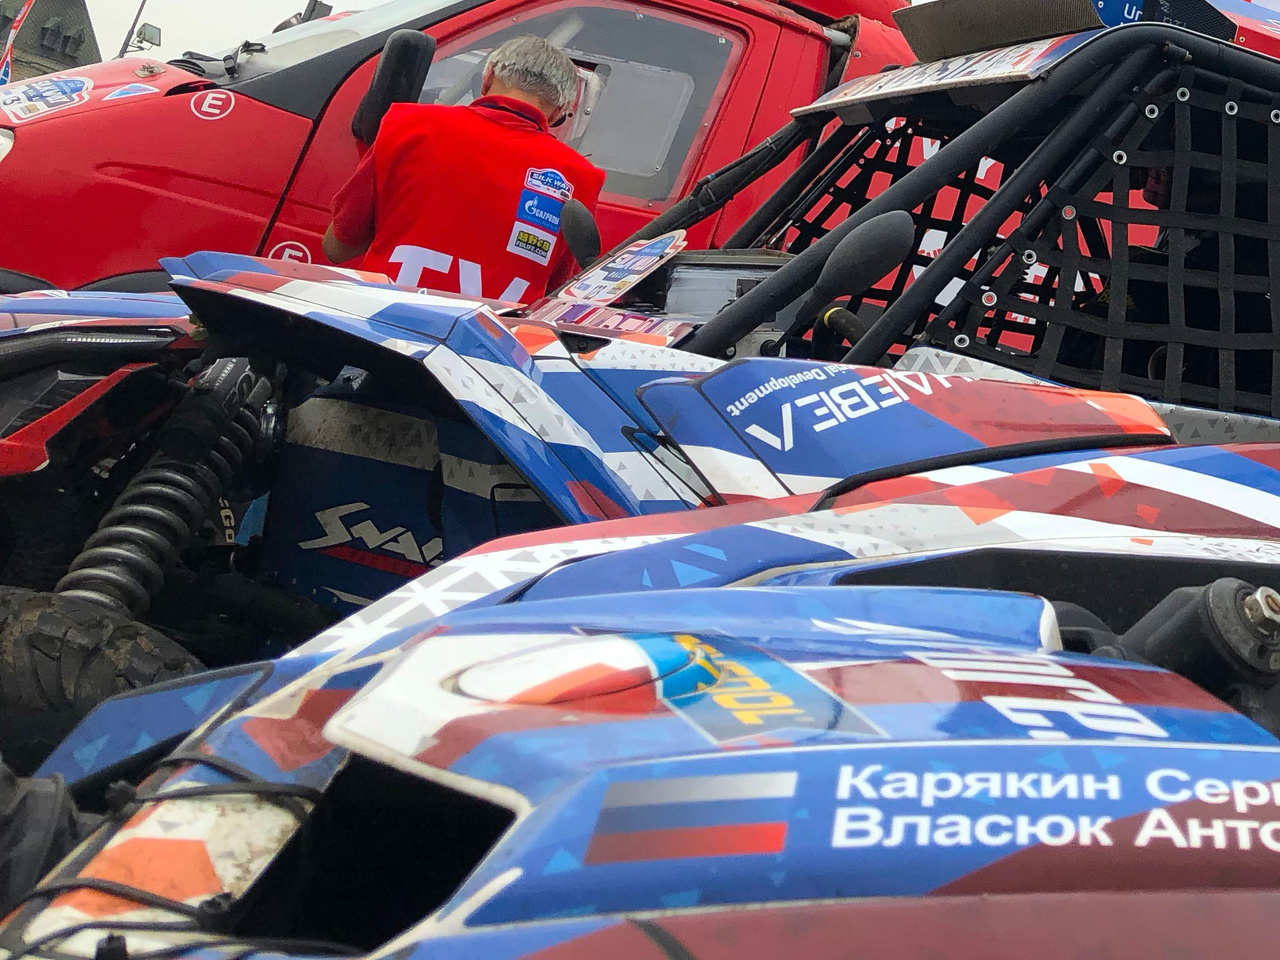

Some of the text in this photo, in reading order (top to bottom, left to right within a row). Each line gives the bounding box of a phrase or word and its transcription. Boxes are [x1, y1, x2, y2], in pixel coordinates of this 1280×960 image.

[200, 93, 227, 114] E
[531, 172, 553, 185] SILK
[726, 366, 828, 418] Development
[836, 764, 1122, 808] Карякин
[830, 806, 1114, 849] Власюк
